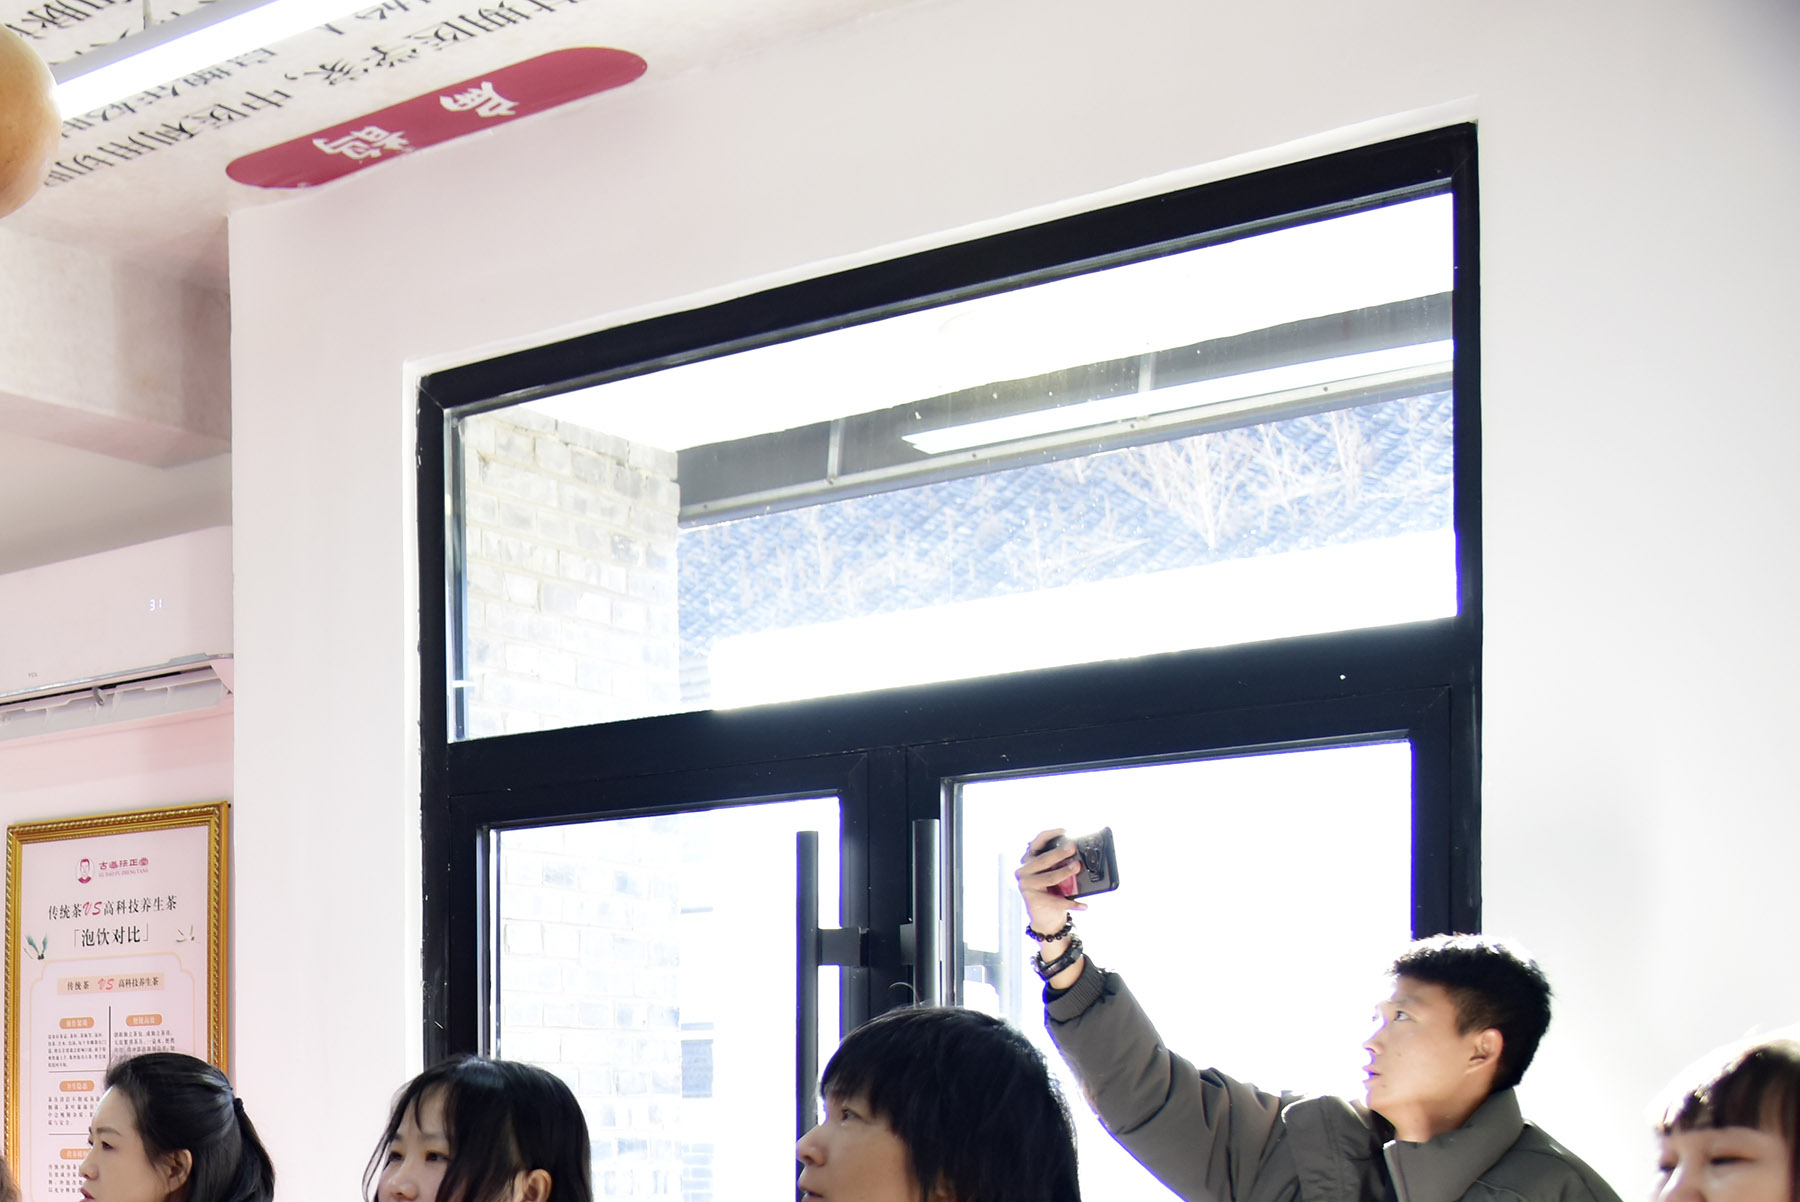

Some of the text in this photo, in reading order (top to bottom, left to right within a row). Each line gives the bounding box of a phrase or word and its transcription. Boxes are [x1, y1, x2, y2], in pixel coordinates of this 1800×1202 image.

[312, 81, 518, 161] 扁鹊
[67, 977, 159, 991] 传统茶 VS 高科技养生茶
